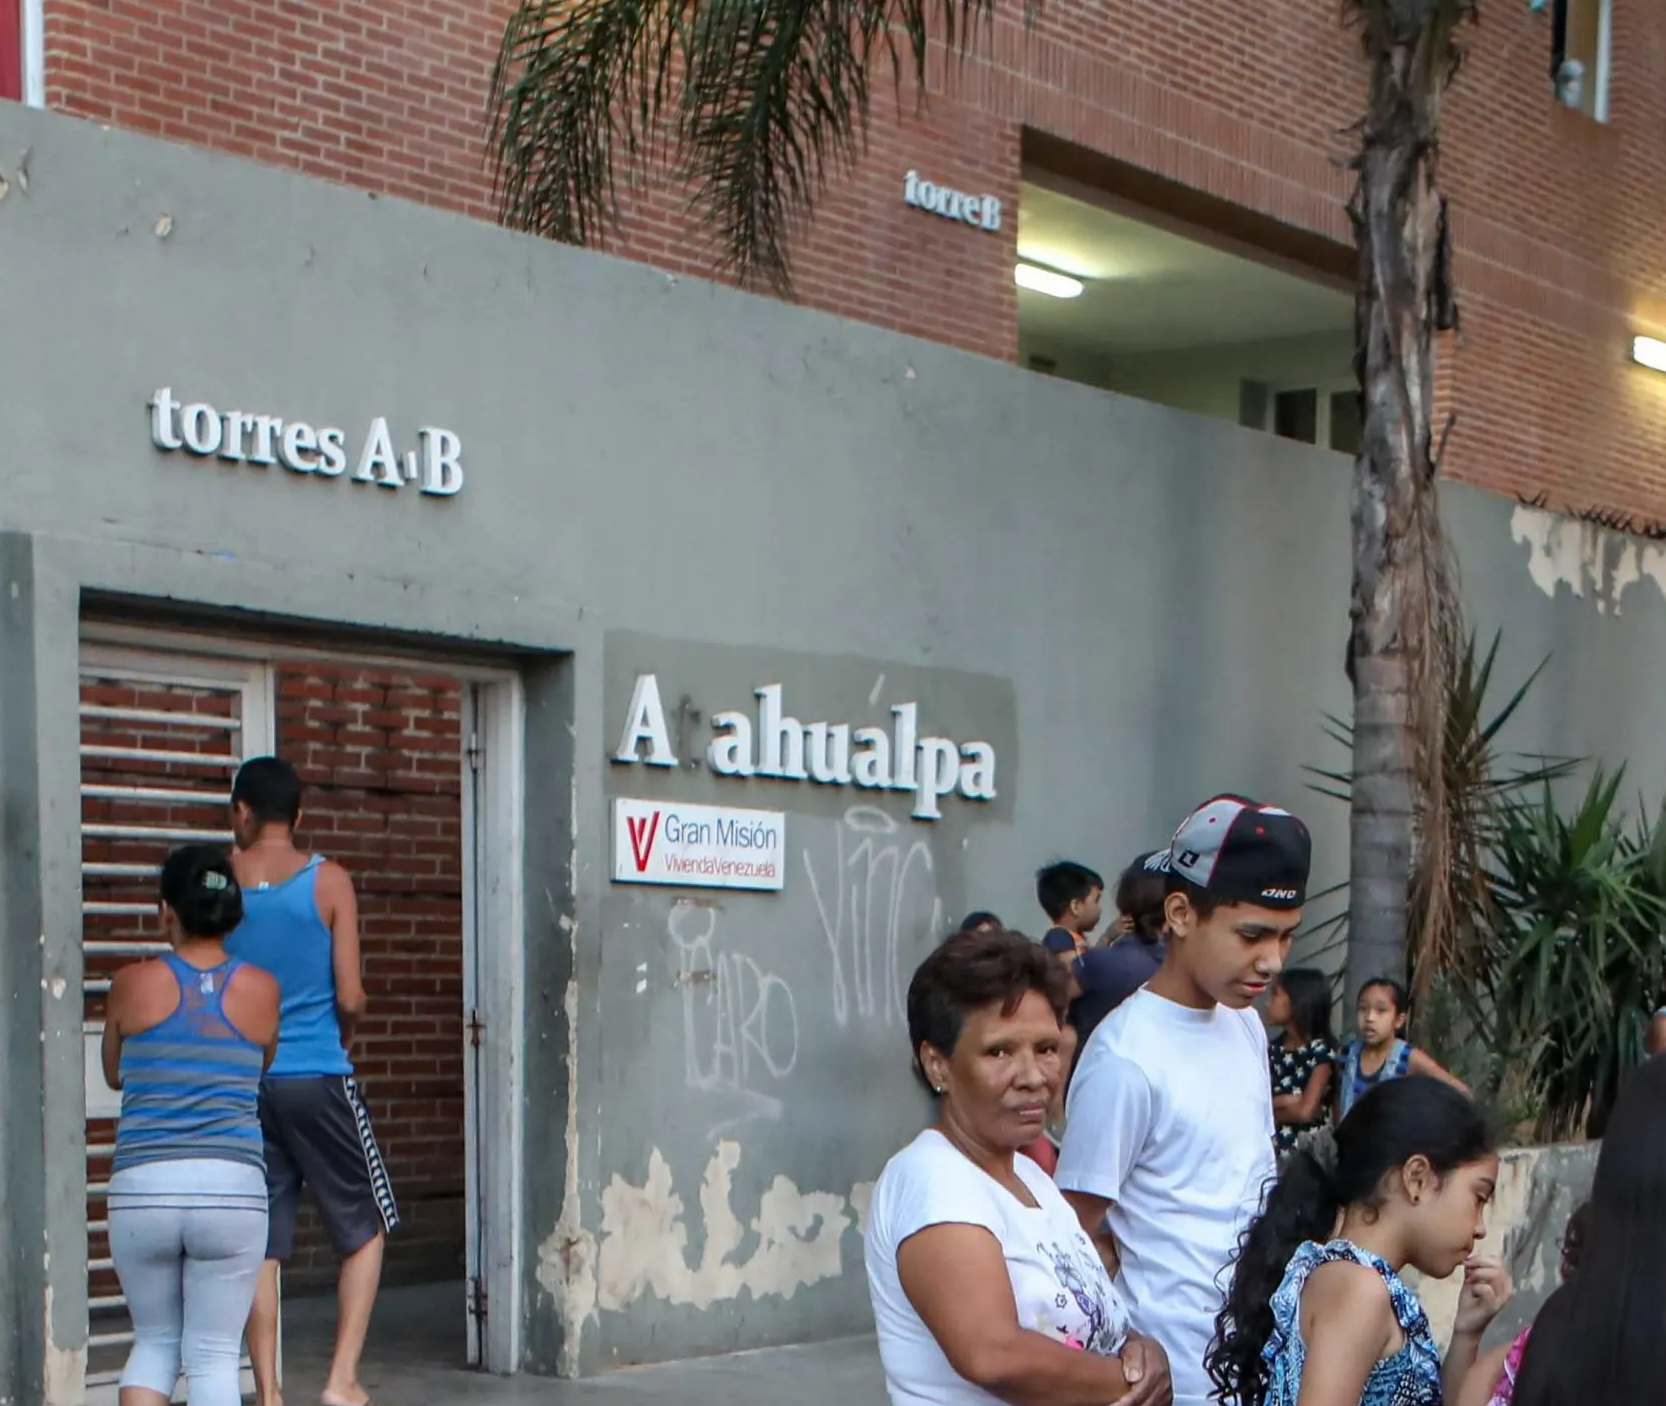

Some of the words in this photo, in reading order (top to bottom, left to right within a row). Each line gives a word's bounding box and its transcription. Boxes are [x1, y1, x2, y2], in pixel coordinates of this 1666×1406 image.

[146, 386, 347, 477] torres
[664, 813, 711, 846] Gran
[716, 817, 777, 850] Misión
[664, 853, 776, 878] ViviendaVenezuela
